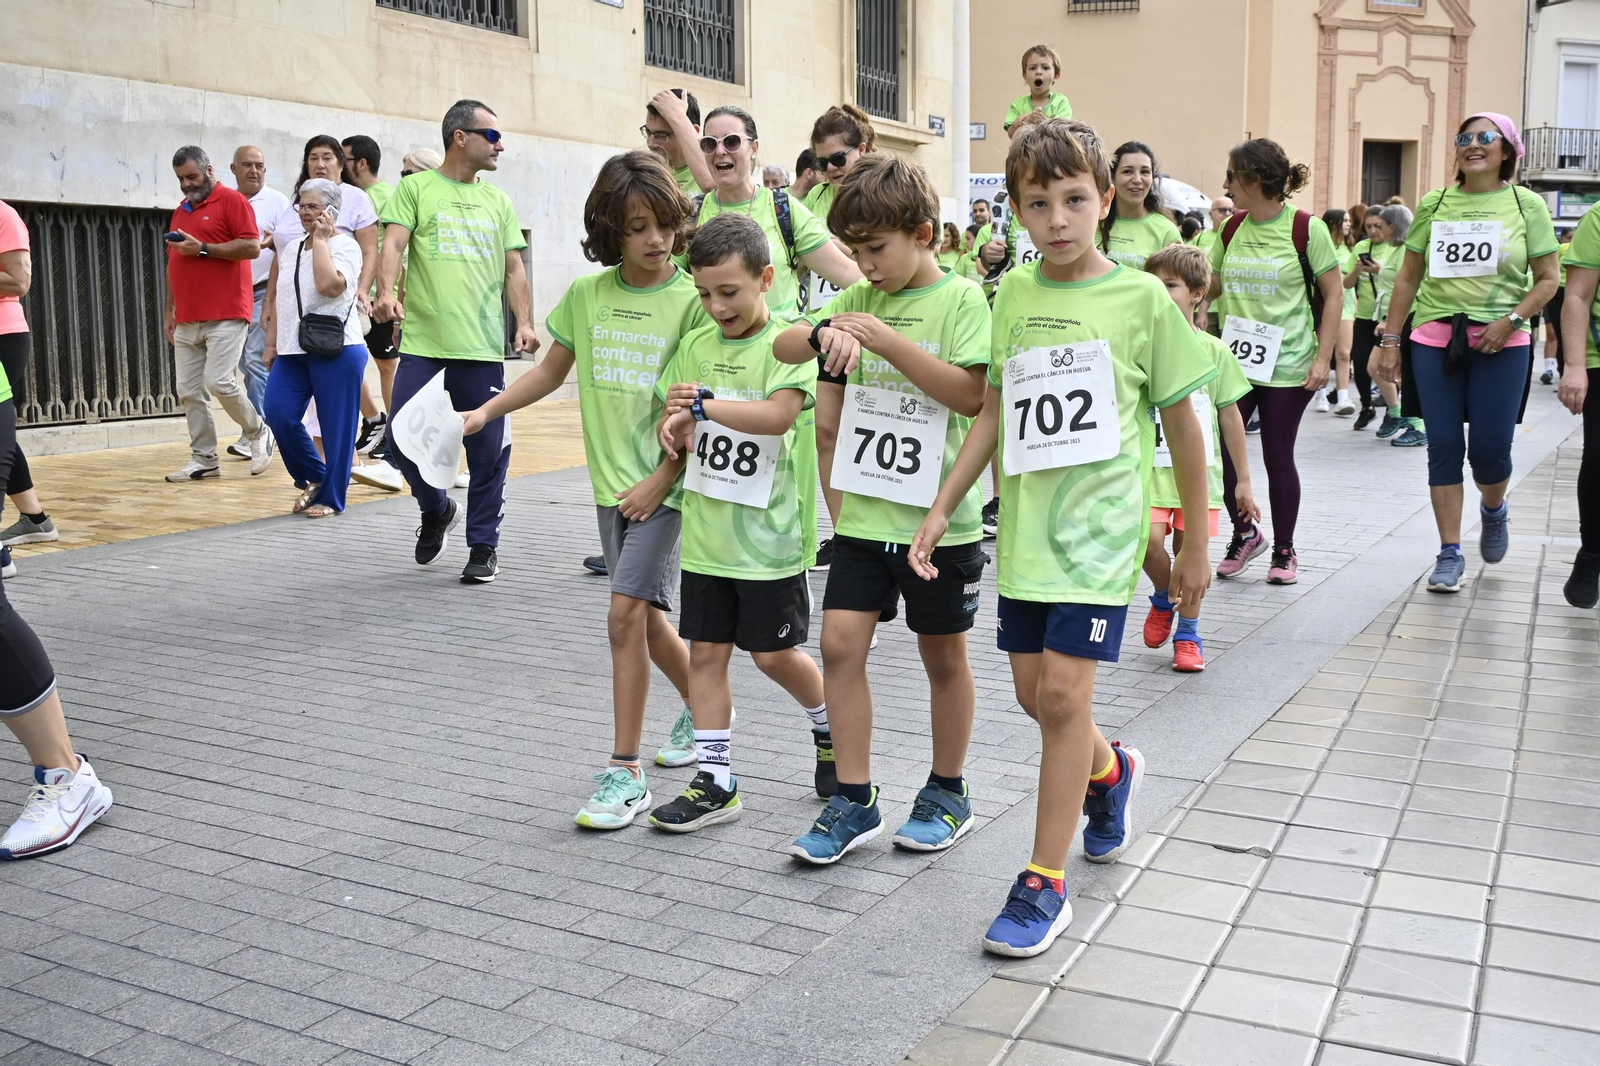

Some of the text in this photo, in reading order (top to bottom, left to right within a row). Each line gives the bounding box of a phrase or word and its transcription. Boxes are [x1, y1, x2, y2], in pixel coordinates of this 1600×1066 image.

[438, 212, 453, 223] En
[428, 213, 438, 261] HUELVA
[1240, 256, 1283, 266] marcha
[1224, 267, 1279, 280] contra el
[1224, 278, 1279, 296] cáncer
[1055, 317, 1081, 326] española
[593, 325, 666, 348] En marcha
[592, 346, 662, 367] contra el
[1230, 339, 1267, 365] 493
[593, 361, 660, 388] cáncer
[1026, 373, 1041, 382] CONTRA
[1047, 368, 1065, 378] CÁNCER
[1073, 366, 1092, 374] HUELVA
[912, 417, 929, 425] HUELVA
[1014, 389, 1097, 441] 702
[853, 426, 922, 475] 703
[1027, 443, 1042, 451] HUELVA
[1048, 439, 1069, 447] OCTUBRE
[1070, 437, 1081, 445] 2025
[696, 431, 761, 477] 488
[860, 470, 876, 478] HUELVA
[1089, 617, 1108, 643] 10
[706, 754, 730, 762] umbro
